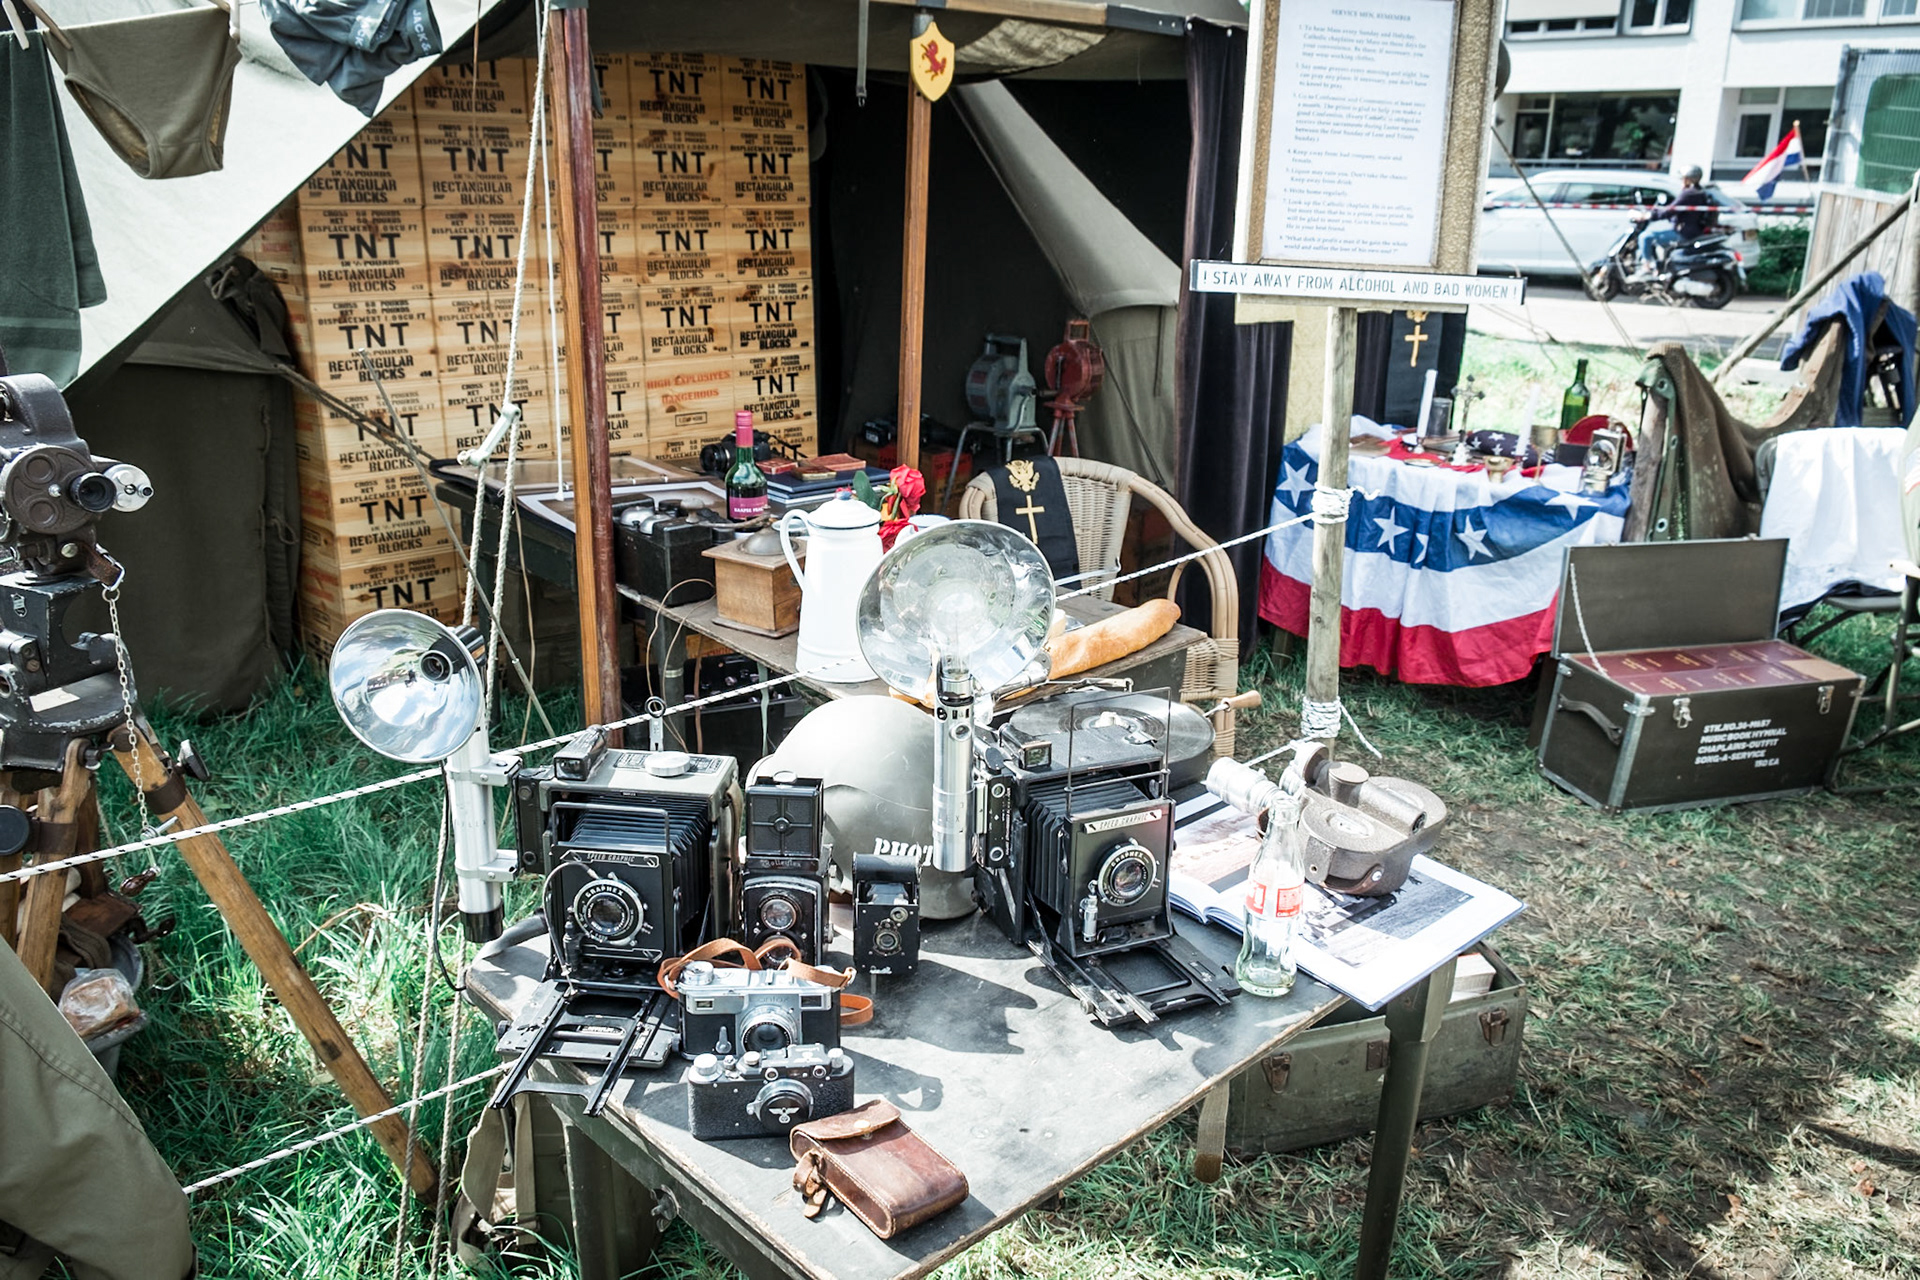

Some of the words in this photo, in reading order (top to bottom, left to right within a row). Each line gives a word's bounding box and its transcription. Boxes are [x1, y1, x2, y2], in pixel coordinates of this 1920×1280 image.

[412, 9, 428, 42] JACK
[1328, 35, 1354, 44] chaplains
[650, 70, 703, 94] TNT
[742, 76, 791, 100] TNT
[424, 87, 504, 101] RECTANGULAR
[453, 101, 497, 113] BLOCKS
[640, 100, 705, 114] RECTANGULAR
[733, 105, 792, 119] RECTANGULAR
[663, 112, 698, 124] BLOCKS
[753, 117, 786, 128] BLOCKS
[328, 143, 393, 169] NT
[443, 147, 509, 172] TNT
[652, 150, 705, 173] TNT
[744, 153, 792, 174] TNT
[308, 178, 396, 191] RECTANGULAR
[433, 181, 512, 192] RECTANGULAR
[643, 181, 707, 192] RECTANGULAR
[735, 182, 794, 192] RECTANGULAR
[339, 192, 388, 203] BLOCKS
[461, 194, 504, 205] BLOCKS
[665, 192, 700, 202] BLOCKS
[755, 192, 787, 202] BLOCKS
[328, 233, 401, 259] TNT
[656, 229, 708, 252] TNT
[745, 229, 793, 250] TNT
[450, 235, 514, 259] TNT
[647, 259, 710, 271] RECTANGULAR
[737, 257, 795, 269] RECTANGULAR
[319, 268, 405, 281] RECTANGULAR
[440, 267, 518, 281] RECTANGULAR
[669, 269, 704, 280] BLOCKS
[757, 267, 789, 278] BLOCKS
[349, 281, 396, 292] BLOCKS
[467, 280, 510, 291] BLOCKS
[1213, 271, 1248, 286] STAY
[1254, 273, 1291, 288] AWAY
[1298, 275, 1333, 290] FROM
[1339, 277, 1395, 293] ALCOHOL
[1402, 280, 1428, 295] AND
[1434, 282, 1459, 296] BAD
[1465, 284, 1508, 298] WOMEN
[661, 305, 712, 328] TNT
[749, 302, 796, 323] TNT
[339, 322, 409, 349] TNT
[652, 333, 714, 347] RECTANGULAR
[740, 328, 797, 340] RECTANGULAR
[673, 344, 707, 355] BLOCKS
[760, 339, 791, 350] BLOCKS
[329, 355, 414, 372] RECTANGULAR
[447, 350, 523, 366] RECTANGULR
[359, 368, 405, 382] BLOCKS
[474, 363, 508, 375] BLOCK
[647, 380, 670, 389] HIGH
[674, 370, 730, 386] EXPLOSIVES
[752, 373, 799, 395] TNT
[662, 388, 719, 404] DANGEROUS
[744, 399, 800, 413] RECTANGULAR
[763, 409, 794, 421] BLOCKS
[369, 459, 414, 472] BLOCKS
[340, 491, 400, 504] DISPLACEMENT
[360, 494, 427, 524] TNT
[350, 526, 431, 547] RECTANGULAR
[378, 539, 423, 554] BLOCKS
[369, 577, 435, 608] TNT
[1700, 734, 1727, 744] MUSIC
[1727, 732, 1751, 741] BOOK
[1751, 728, 1787, 738] HYMNAL
[761, 859, 801, 868] Rolleiflex
[1111, 851, 1144, 867] GRAPHEX
[585, 885, 624, 898] GRAPHEX
